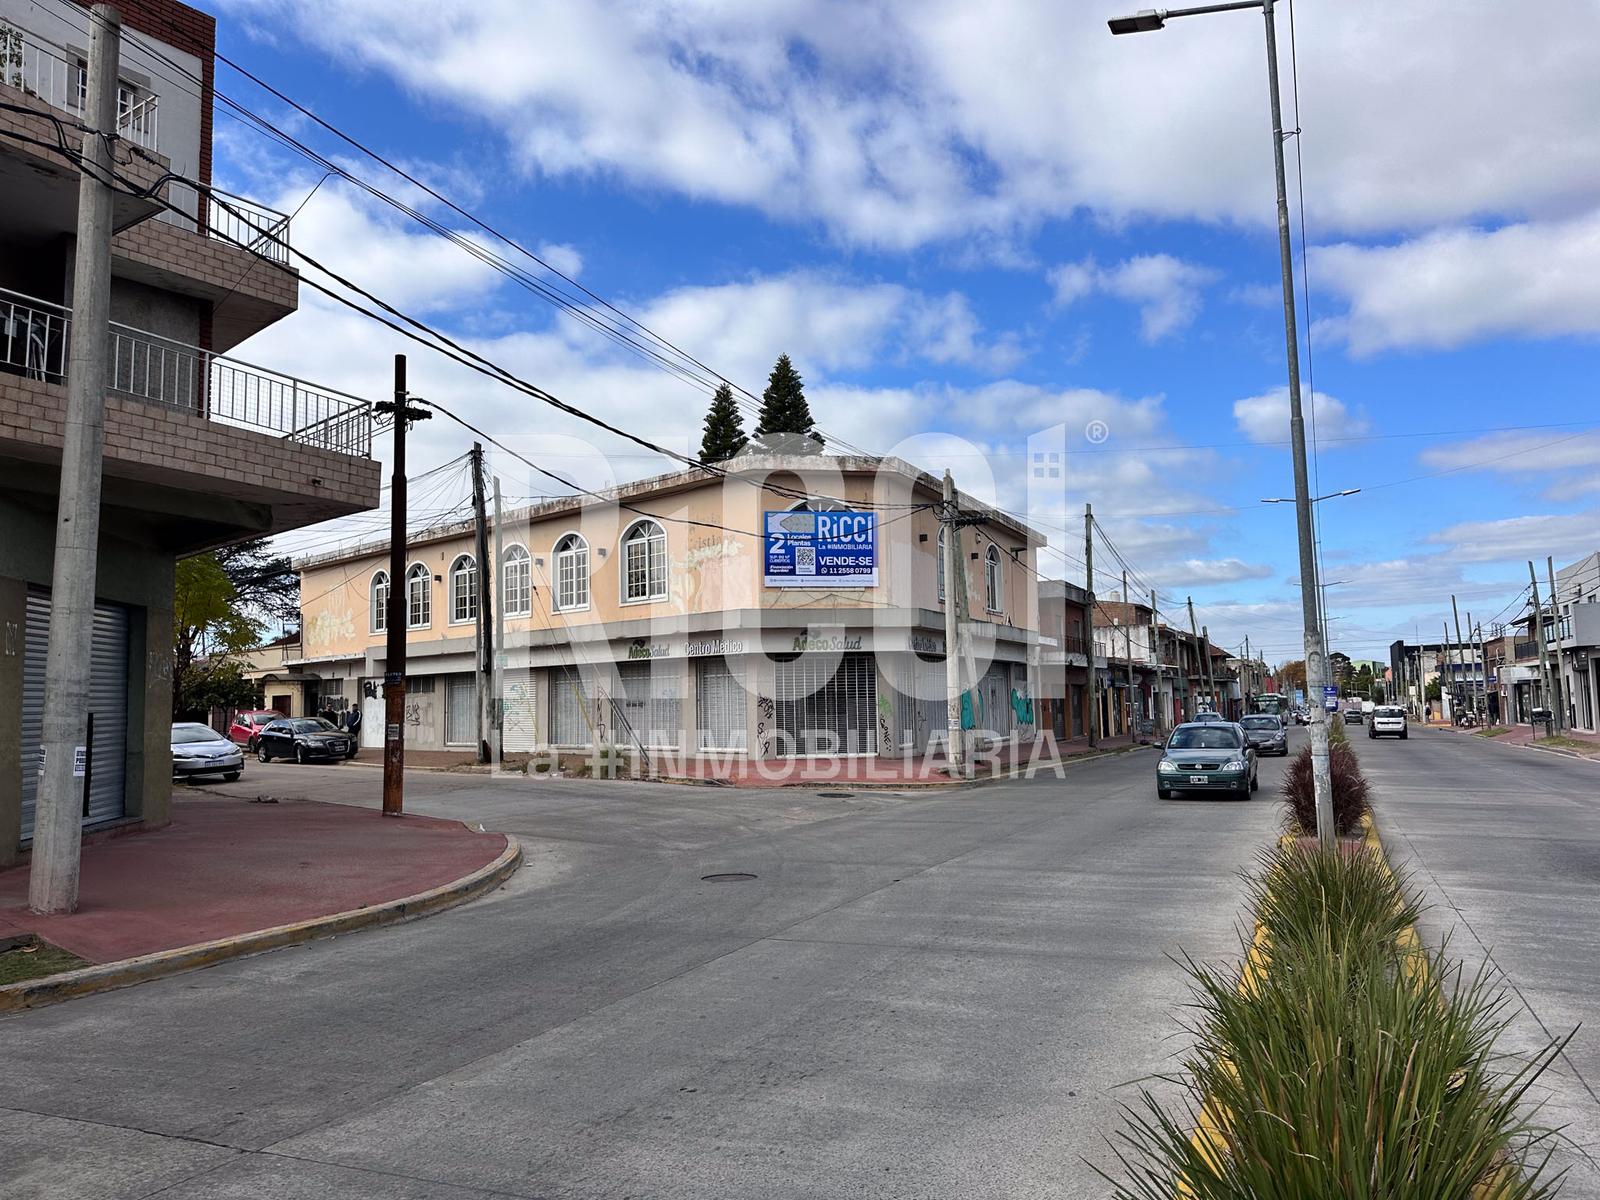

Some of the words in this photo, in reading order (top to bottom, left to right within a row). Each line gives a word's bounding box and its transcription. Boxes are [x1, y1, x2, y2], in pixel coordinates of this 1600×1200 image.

[770, 534, 785, 553] 2
[819, 556, 873, 566] VENDE-SE
[684, 642, 711, 656] Centro
[712, 639, 743, 654] Médico
